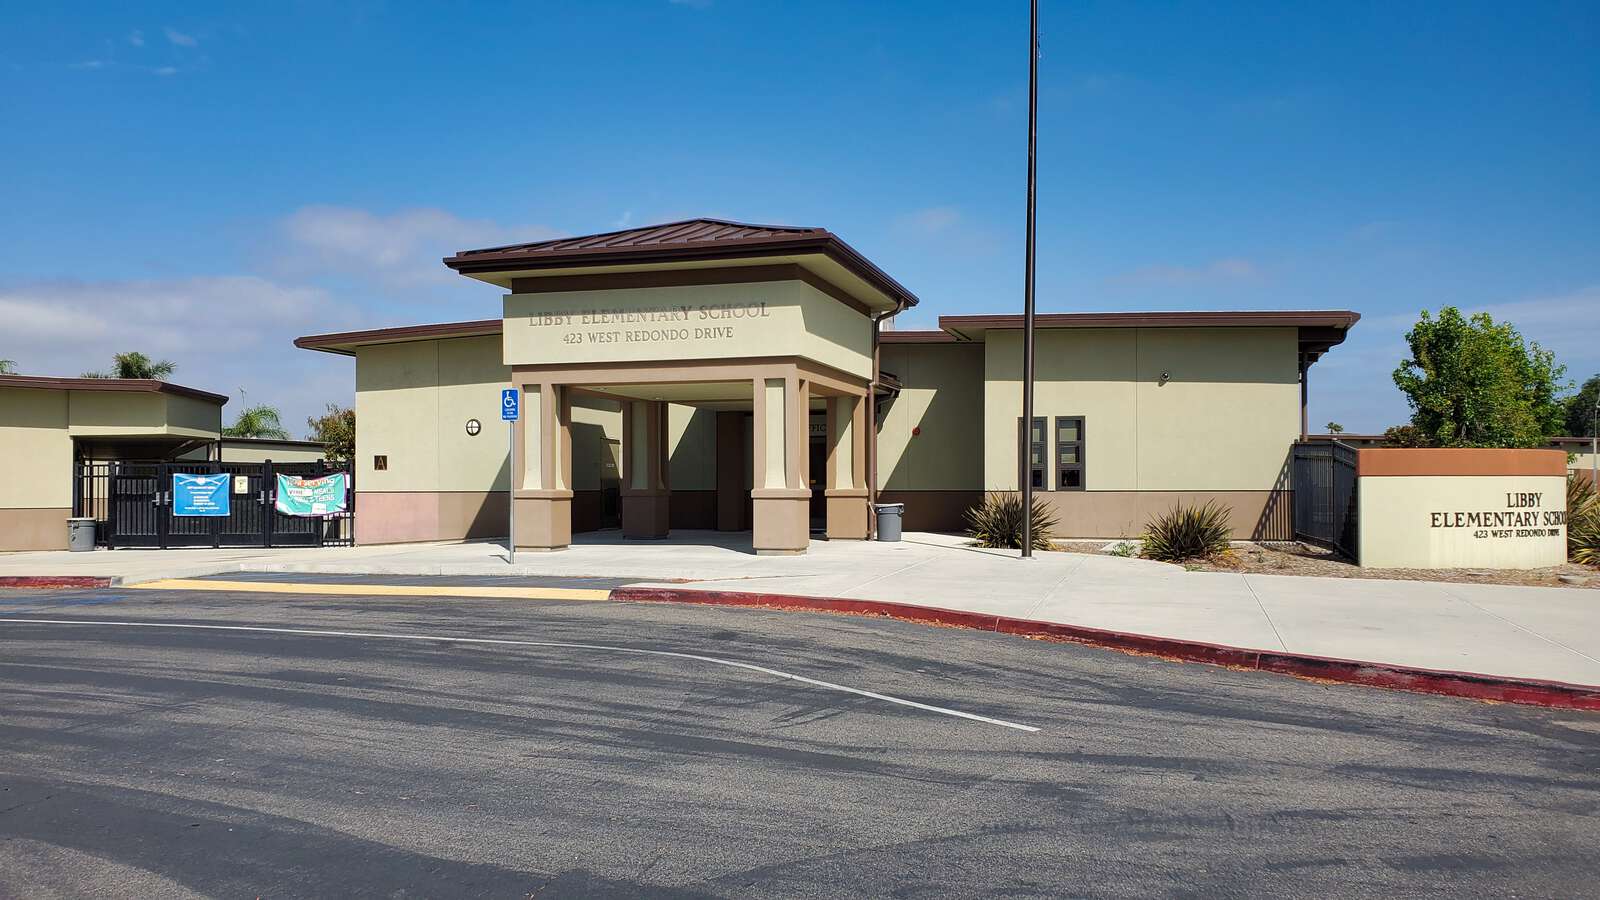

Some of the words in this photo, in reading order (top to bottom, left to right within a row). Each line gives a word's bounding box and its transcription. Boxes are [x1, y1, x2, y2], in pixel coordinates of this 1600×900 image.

[528, 311, 573, 327] LIBBY
[581, 305, 693, 325] ELEMENTARY
[699, 302, 770, 320] SCHOOL
[562, 333, 583, 344] 423
[588, 331, 620, 344] WEST
[625, 328, 689, 343] REDONDO
[695, 326, 734, 339] DRIVE
[376, 456, 387, 470] A
[1506, 492, 1543, 508] LIBBY
[1431, 511, 1540, 528] ELEMENTARY
[1543, 510, 1567, 526] SCHOO
[1473, 530, 1489, 539] 423
[1491, 529, 1513, 539] WEST
[1515, 529, 1547, 538] REDONDO
